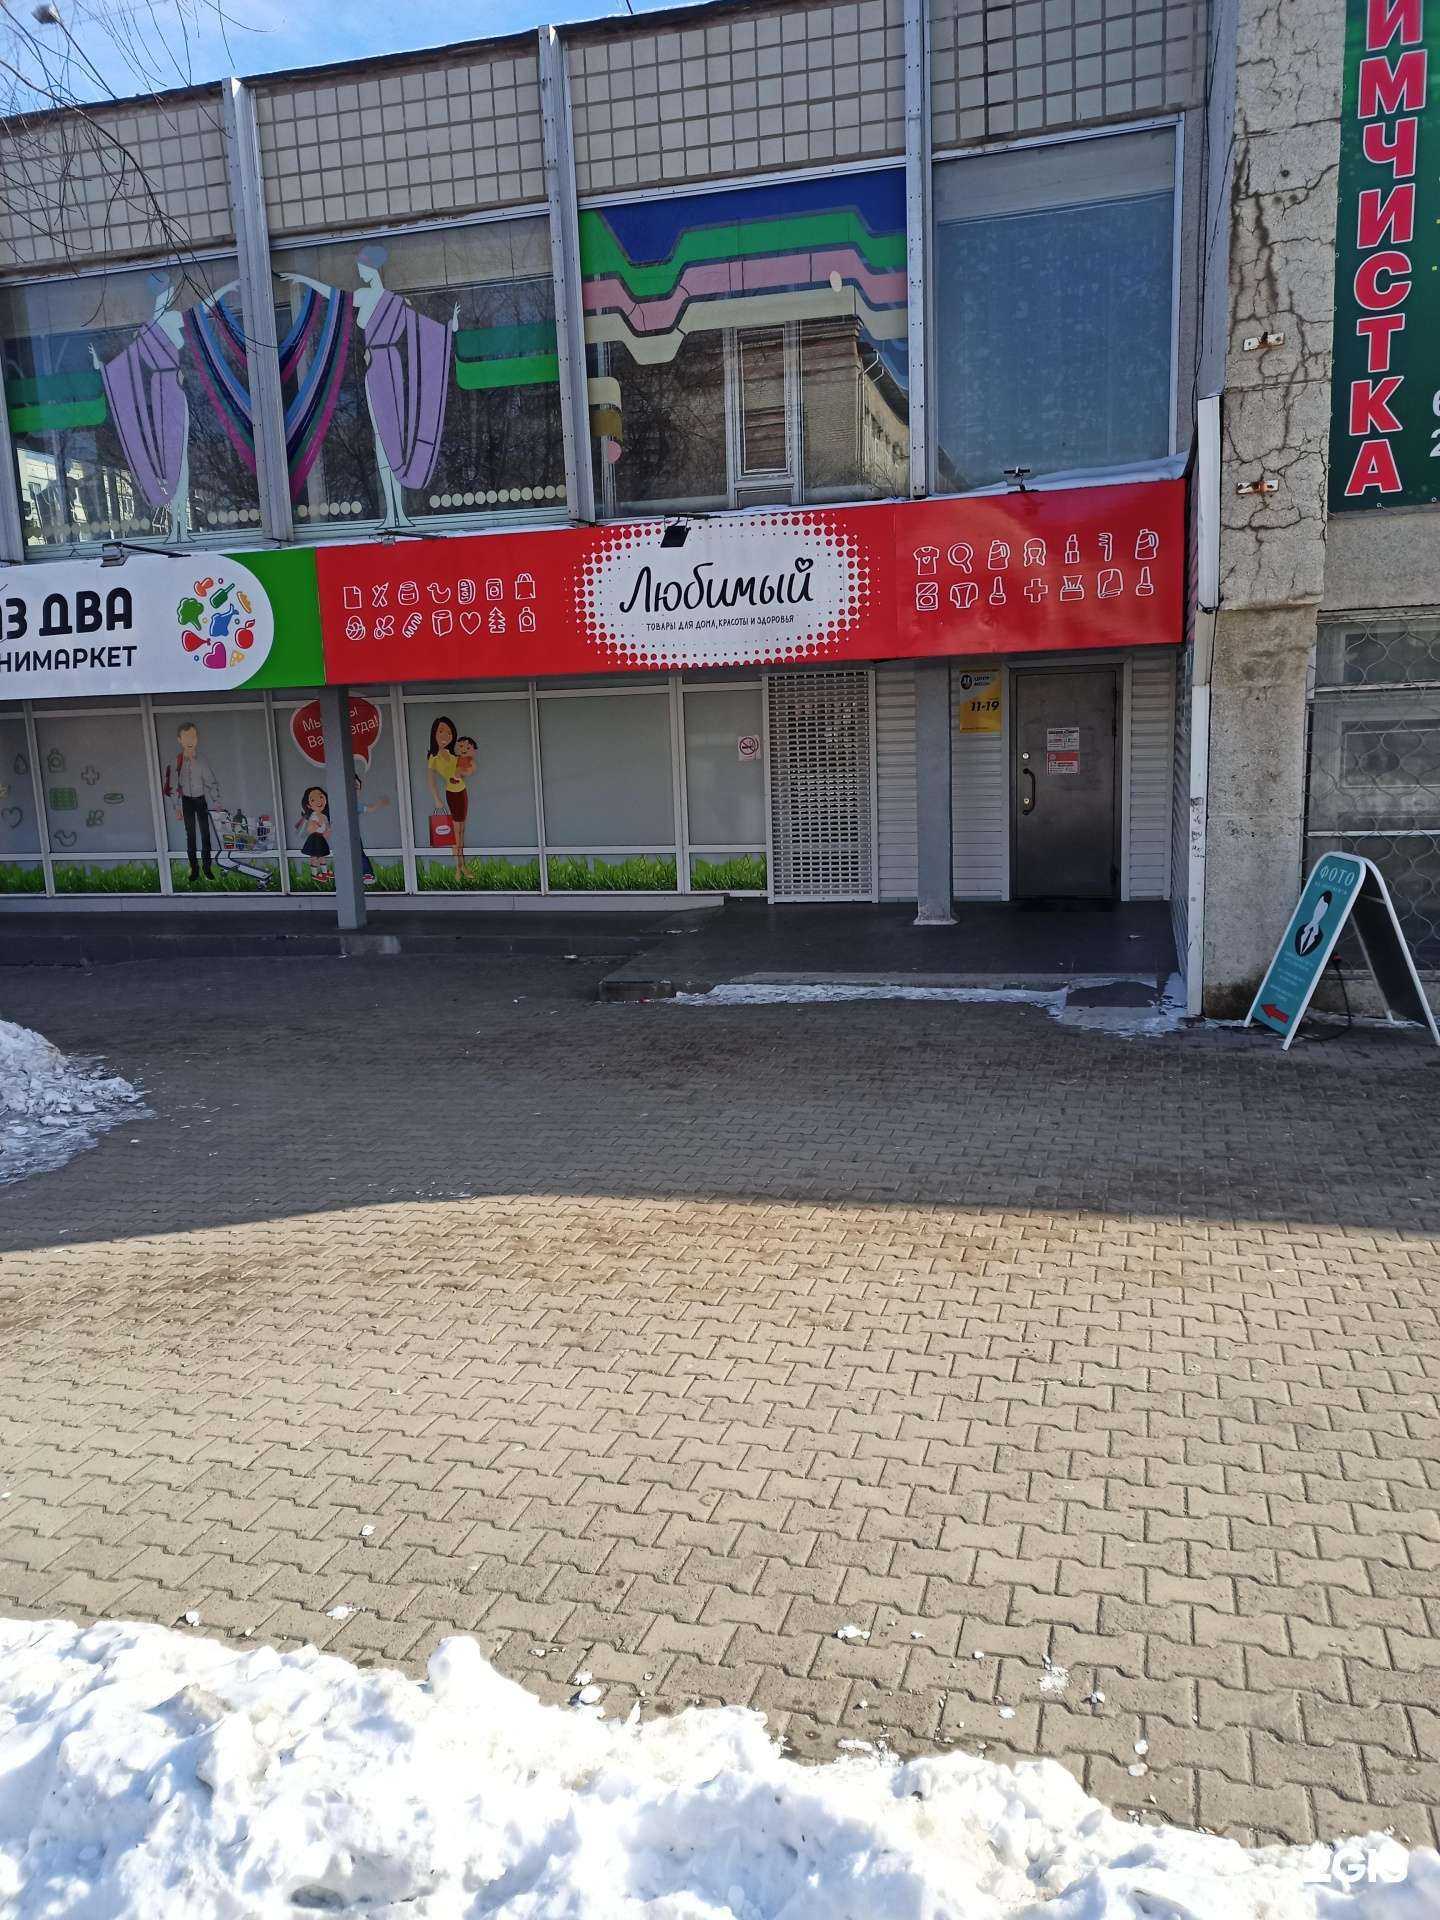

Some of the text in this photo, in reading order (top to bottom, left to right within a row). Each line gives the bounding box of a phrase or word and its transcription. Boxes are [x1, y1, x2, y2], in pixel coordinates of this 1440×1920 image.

[619, 556, 814, 614] Любимый
[39, 587, 133, 637] ДВА
[646, 622, 676, 632] ТОВАРЫ
[678, 620, 694, 631] ДЛЯ
[718, 616, 749, 628] КРАСОТЫ
[750, 616, 756, 625] И
[756, 614, 795, 626] ЗДОРОВЬЯ
[970, 700, 1000, 712] 11-19
[308, 735, 324, 748] Ва
[1320, 865, 1355, 886] ФОТО
